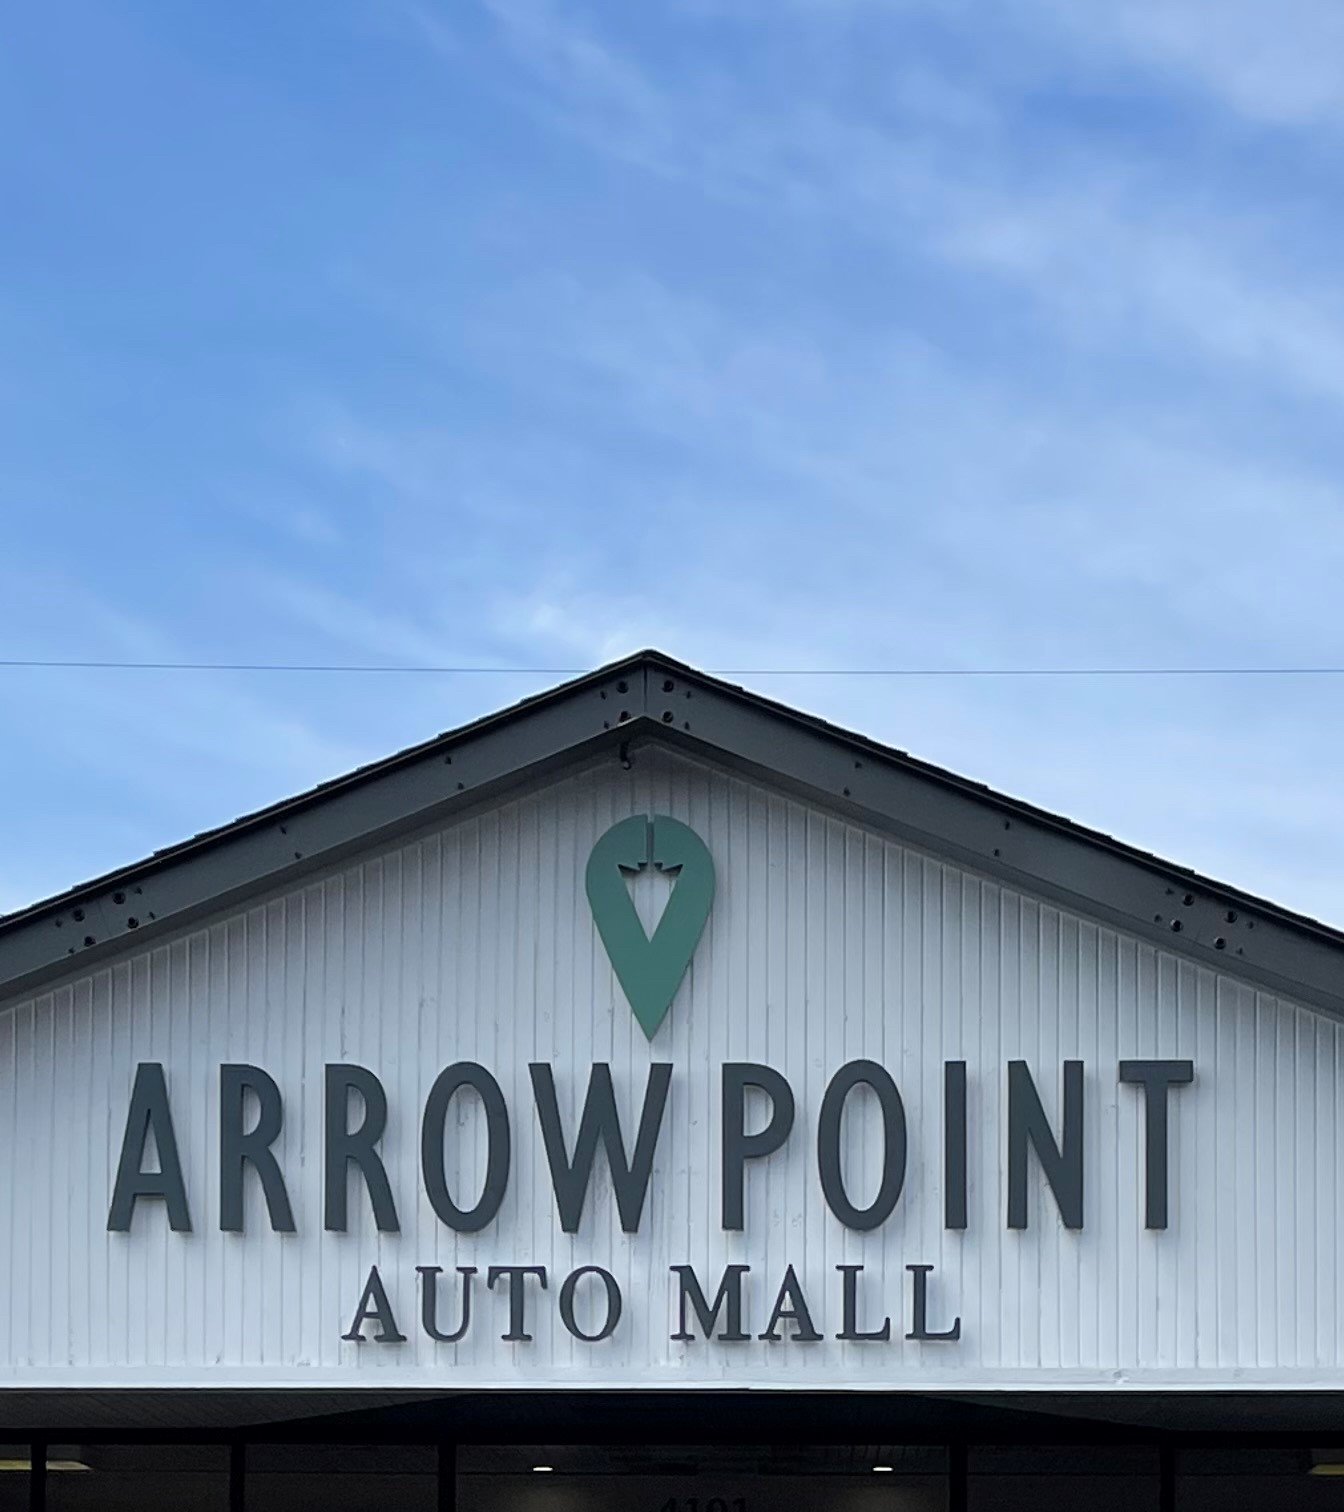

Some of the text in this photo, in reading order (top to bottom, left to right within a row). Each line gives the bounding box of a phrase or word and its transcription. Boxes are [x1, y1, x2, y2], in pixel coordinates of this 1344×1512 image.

[106, 1059, 1194, 1233] ARROW POINT
[341, 1264, 961, 1342] AUTO MALL
